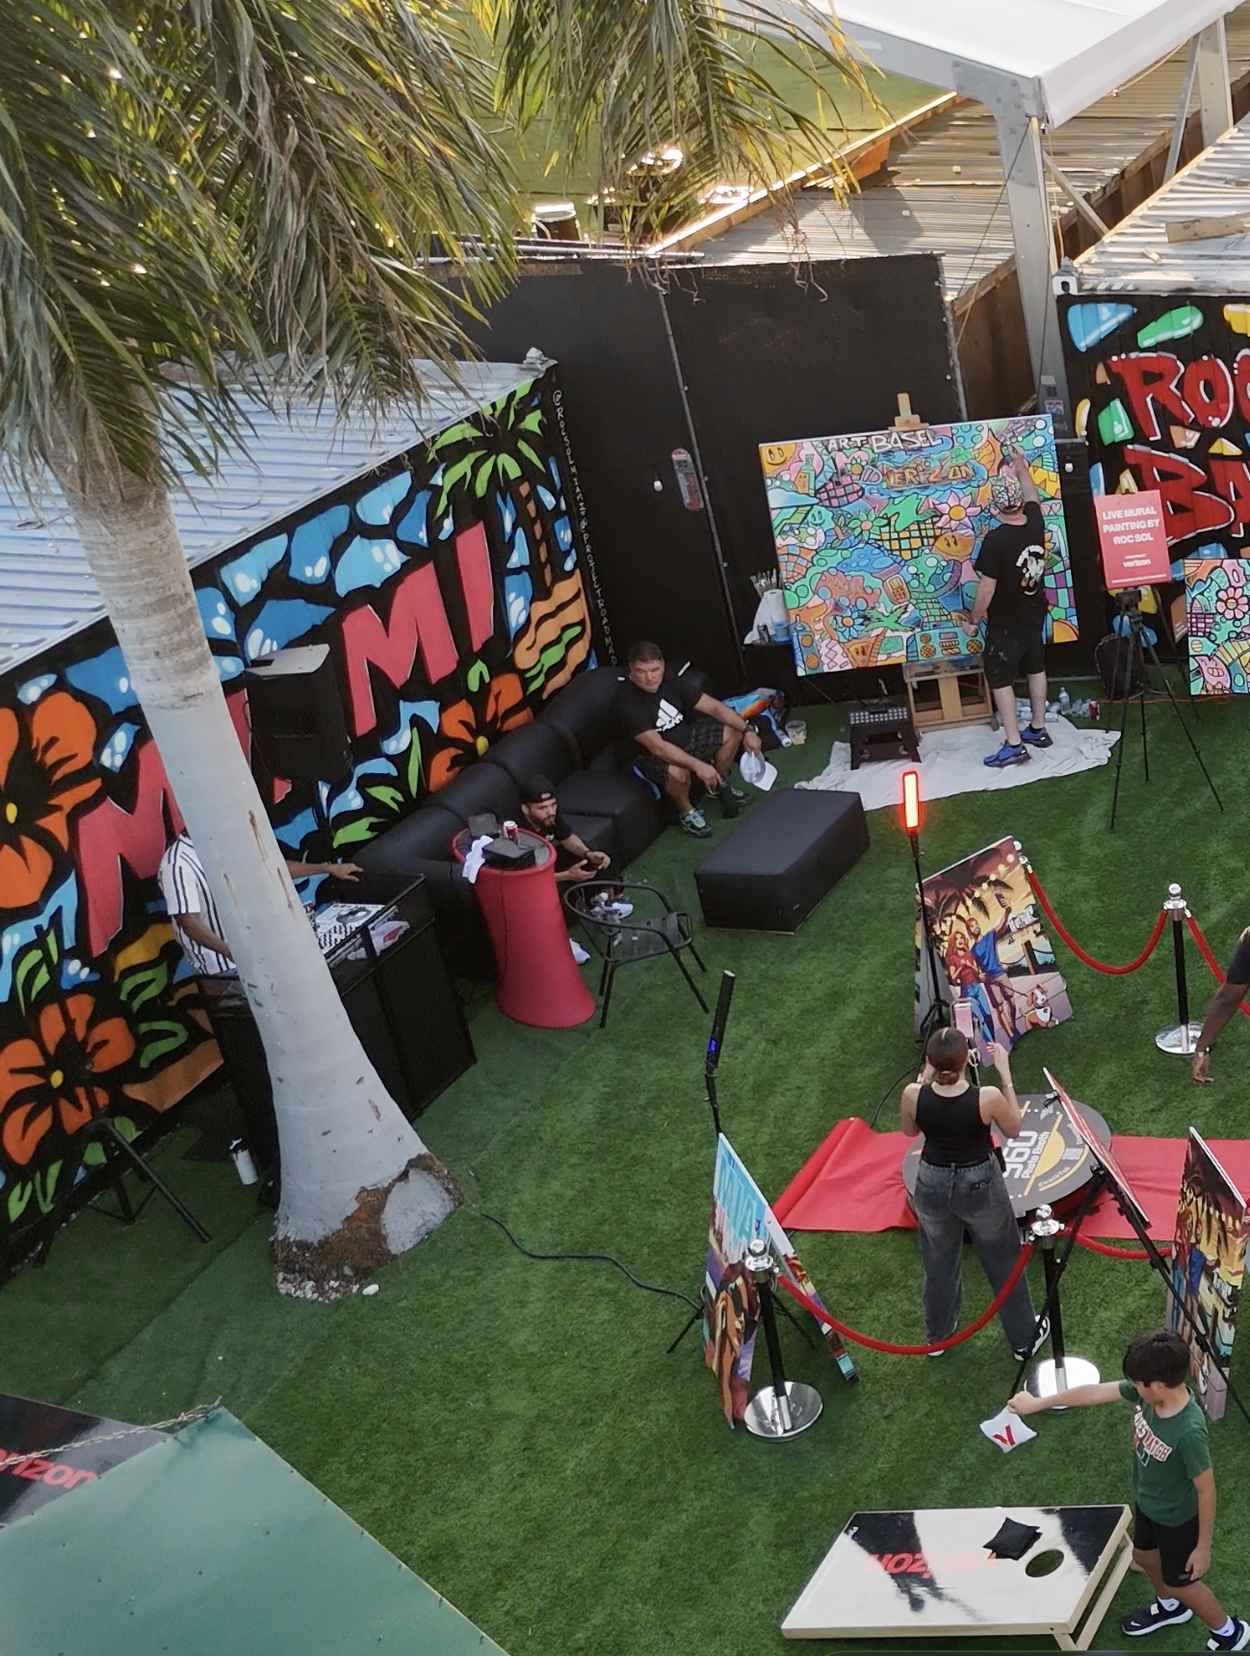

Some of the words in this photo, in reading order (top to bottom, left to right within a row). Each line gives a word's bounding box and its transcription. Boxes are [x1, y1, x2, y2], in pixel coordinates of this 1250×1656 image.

[828, 435, 868, 451] ART
[870, 429, 942, 453] BASEL
[1102, 509, 1124, 520] LIVE
[1124, 506, 1157, 518] MURAL
[1102, 521, 1147, 534] PAINTING
[1147, 518, 1160, 528] BY
[1113, 535, 1134, 545] ROC
[1134, 532, 1155, 543] SOL
[1122, 558, 1152, 568] verizon
[78, 522, 496, 957] MMI
[1020, 1154, 1040, 1179] Photo
[1035, 1131, 1050, 1155] Booth
